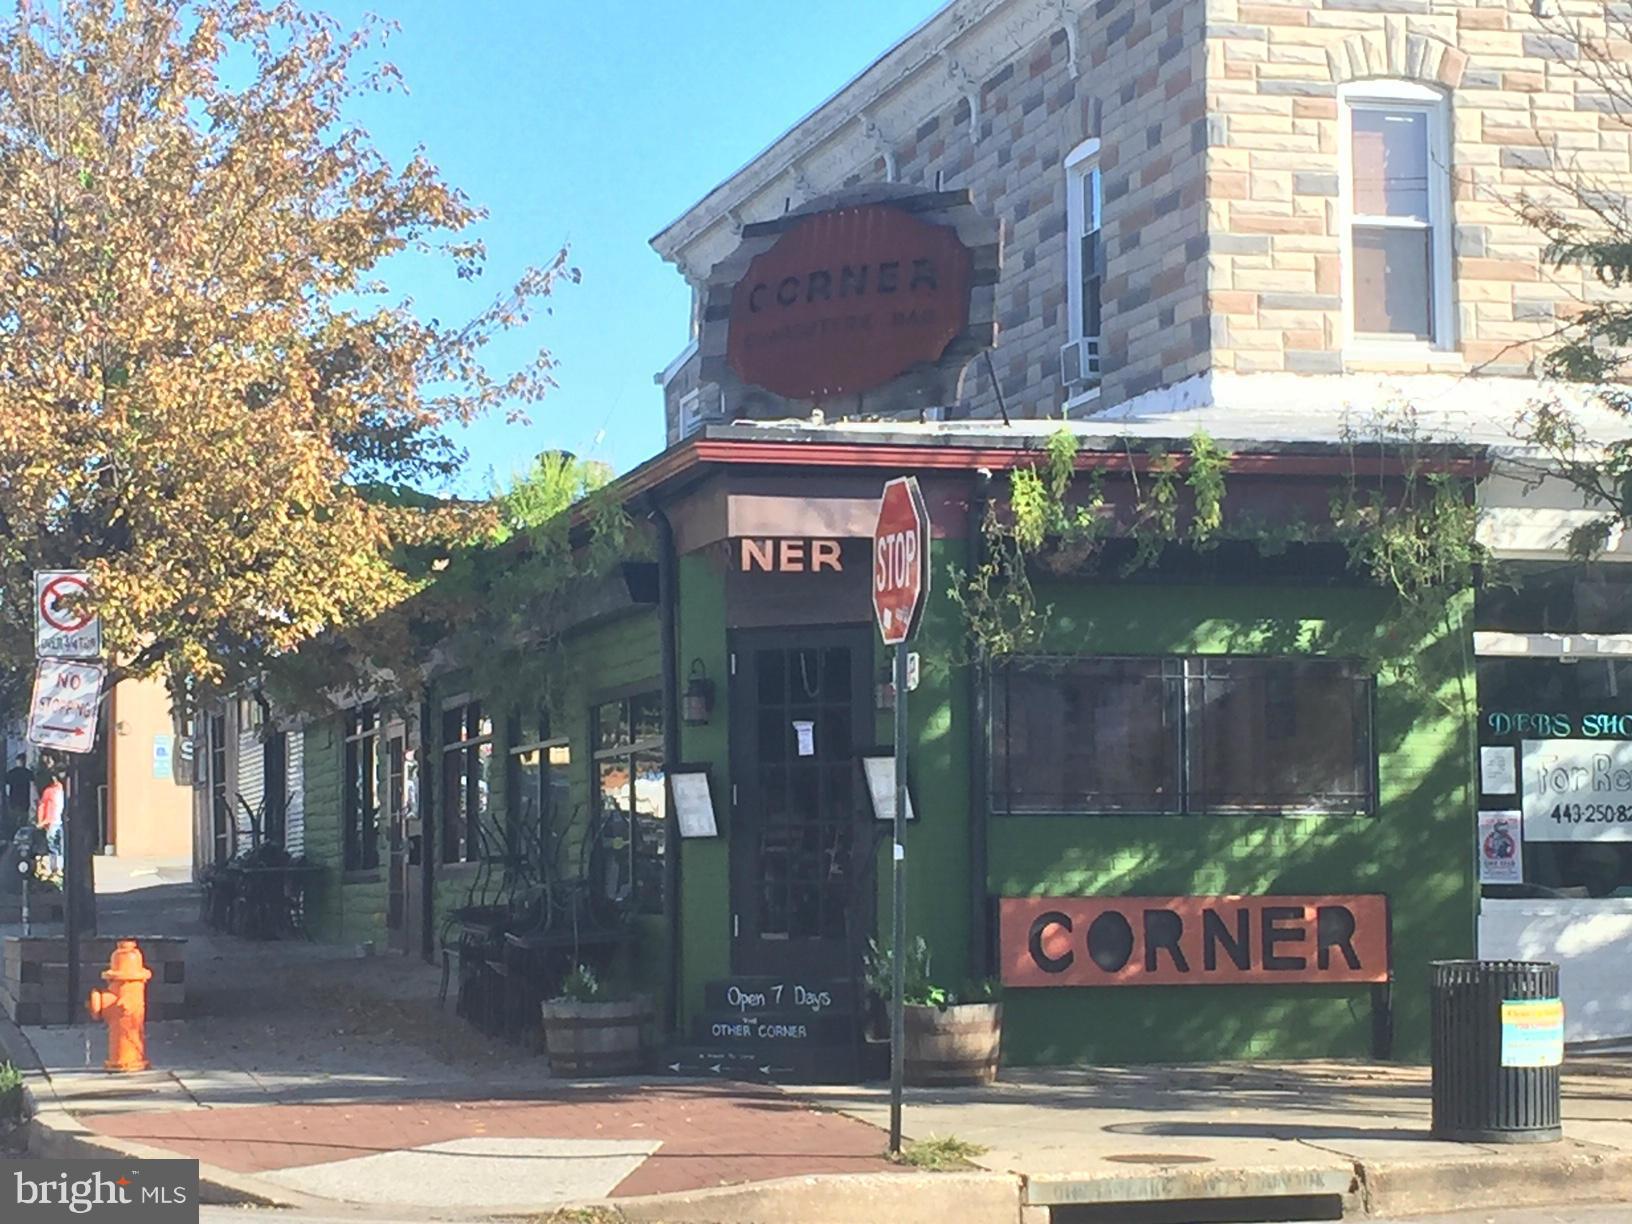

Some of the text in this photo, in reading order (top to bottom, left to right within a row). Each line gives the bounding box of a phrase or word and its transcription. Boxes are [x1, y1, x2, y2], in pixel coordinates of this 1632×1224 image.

[749, 257, 938, 313] CORNER
[741, 538, 843, 571] NER
[877, 529, 916, 593] STOP
[56, 672, 81, 690] NO
[1488, 712, 1571, 737] DEBS
[1592, 753, 1632, 792] Re
[1028, 905, 1362, 974] CORNER
[727, 984, 831, 1013] Open 7 Days
[712, 1024, 807, 1038] OTHER CORNER
